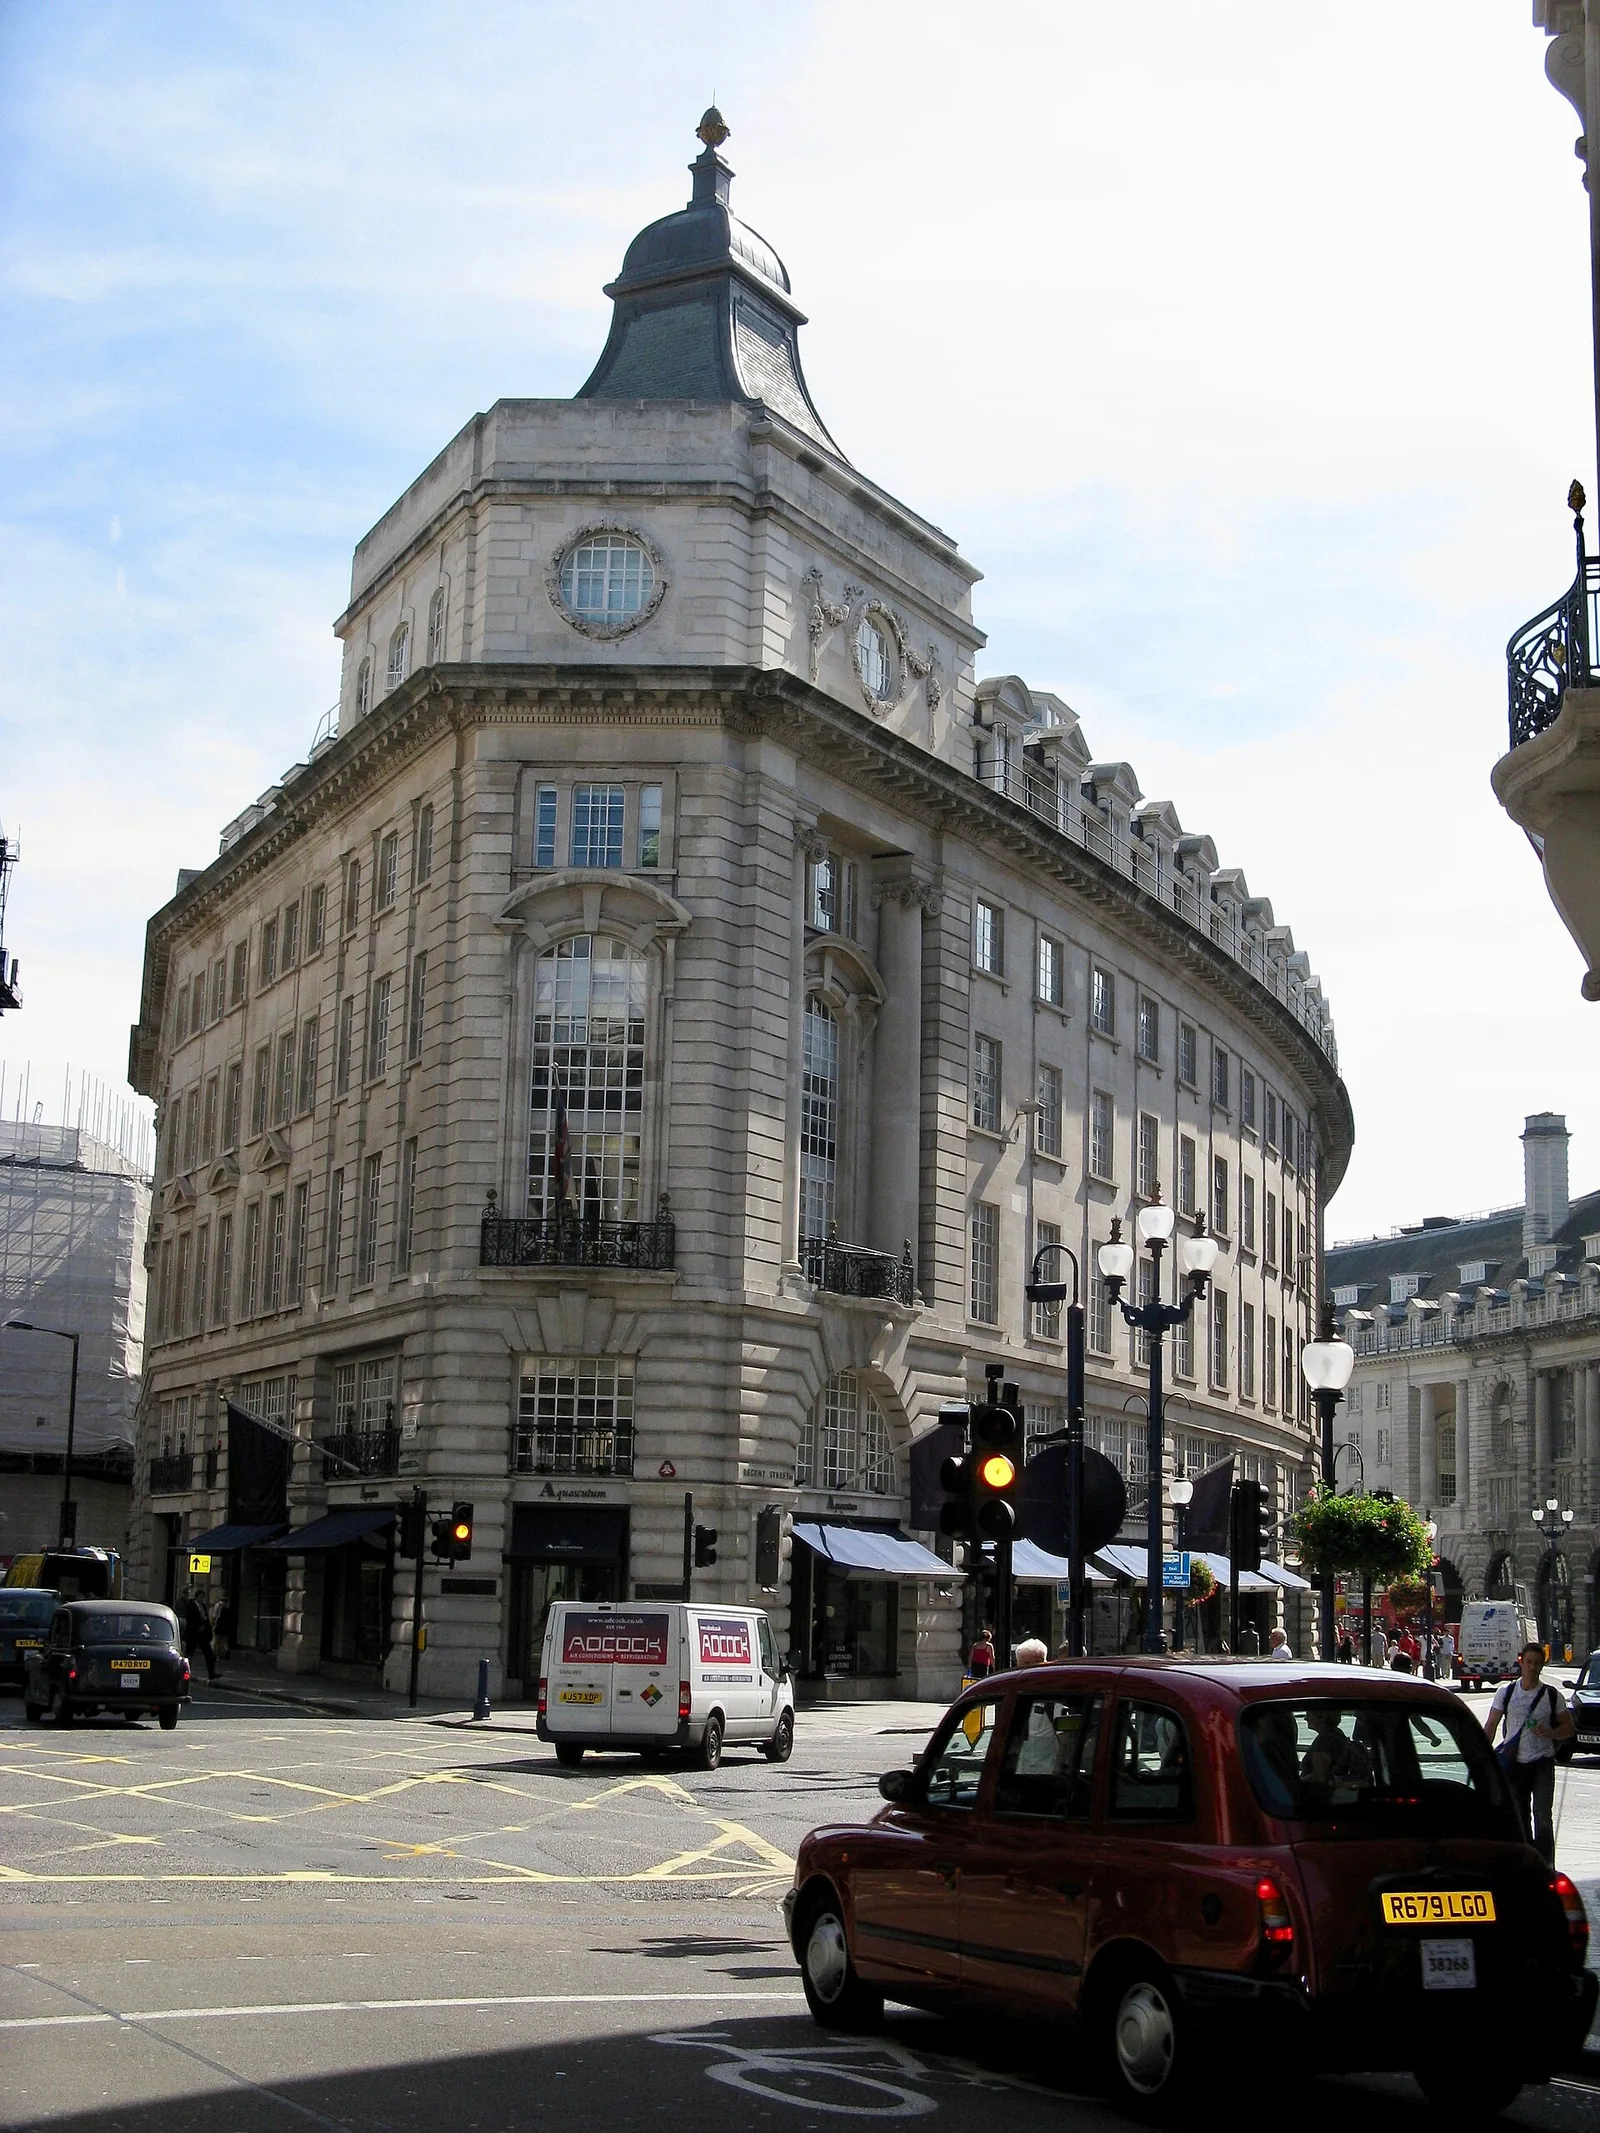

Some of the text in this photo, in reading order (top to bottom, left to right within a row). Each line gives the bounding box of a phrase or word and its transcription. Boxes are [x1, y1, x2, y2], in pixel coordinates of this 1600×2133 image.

[743, 1469, 766, 1478] REGENT
[770, 1470, 789, 1480] STREET
[538, 1482, 607, 1501] Aquascutum
[568, 1636, 662, 1653] ADCOCK
[702, 1634, 750, 1659] ADCOCK
[562, 1691, 583, 1700] AJ57
[1390, 1895, 1488, 1919] R679 LGO
